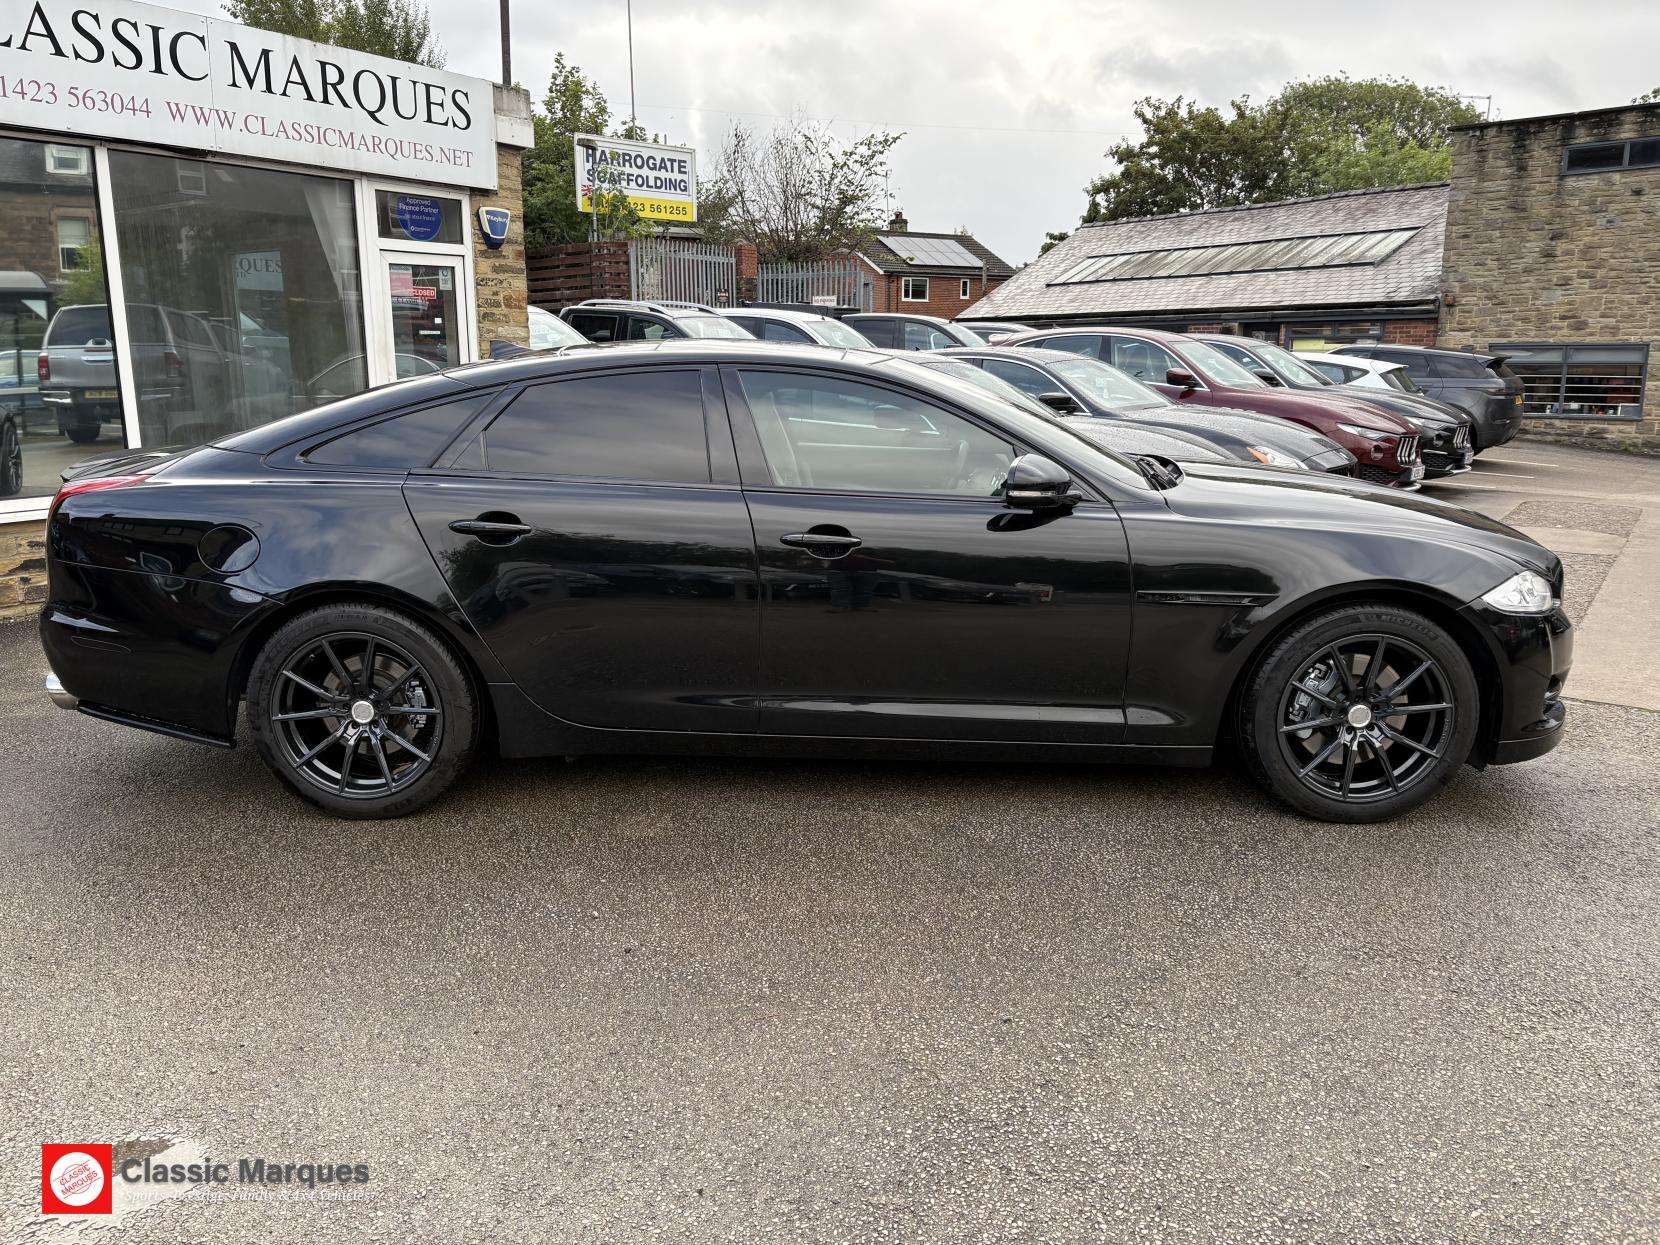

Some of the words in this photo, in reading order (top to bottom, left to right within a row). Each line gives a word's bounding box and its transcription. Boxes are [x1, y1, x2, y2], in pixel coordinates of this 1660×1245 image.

[0, 75, 58, 105] 1423
[67, 86, 152, 118] 563044
[165, 101, 473, 168] WWW.CLASSICMARQUES.NET
[224, 40, 472, 131] MARQUES
[649, 203, 687, 215] 561255
